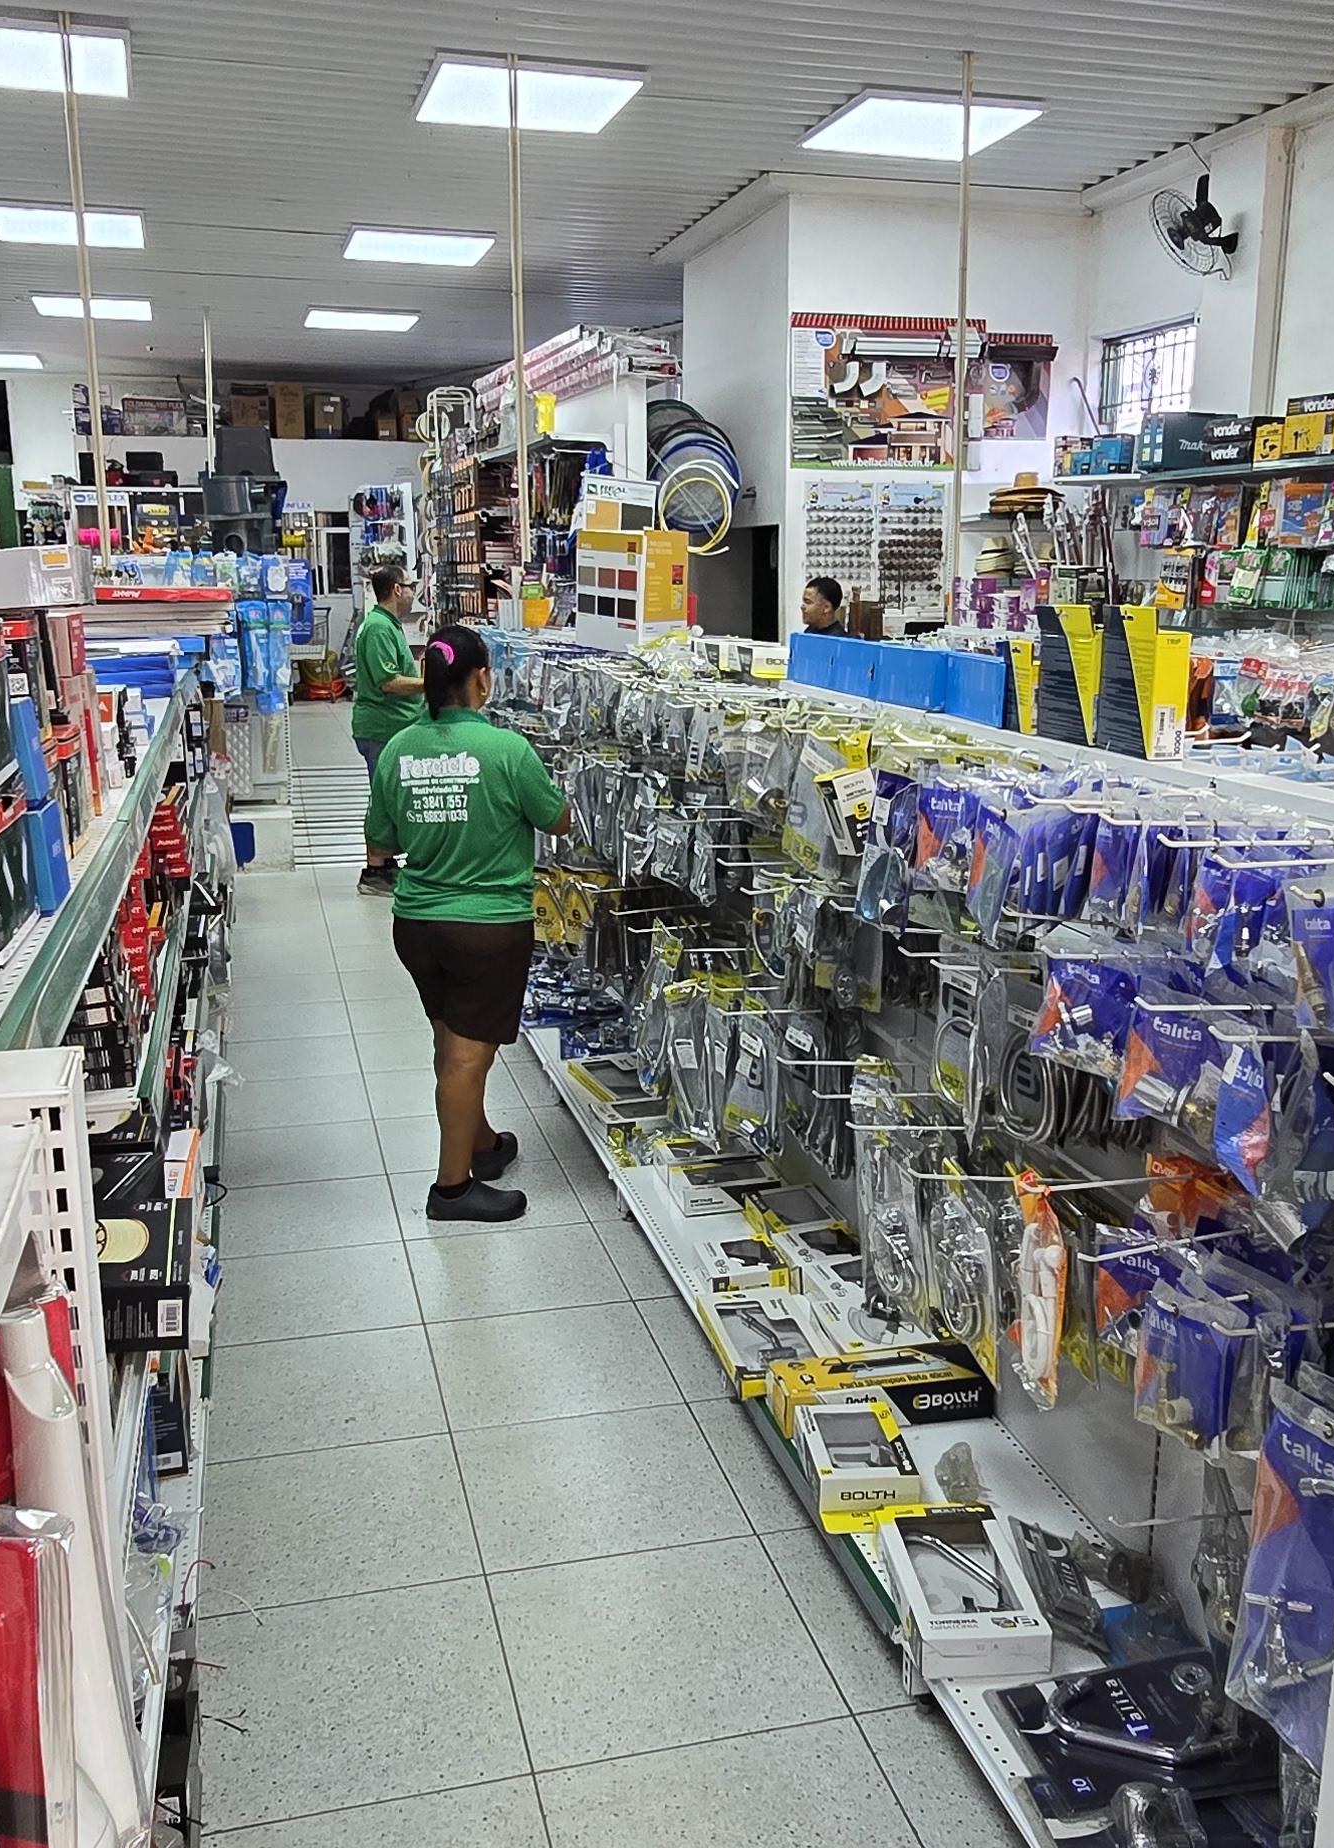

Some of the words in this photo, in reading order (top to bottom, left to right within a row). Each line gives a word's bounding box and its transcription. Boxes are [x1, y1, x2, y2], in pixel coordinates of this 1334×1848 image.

[1213, 421, 1242, 437] vonder
[1211, 445, 1240, 461] vonder
[831, 457, 935, 468] www.bellacalha.com.br
[1166, 638, 1182, 646] TRIP
[1173, 730, 1182, 756] DOCOL
[400, 751, 481, 780] Fercicle
[1153, 1016, 1202, 1042] talita
[840, 1489, 896, 1501] BOLTH
